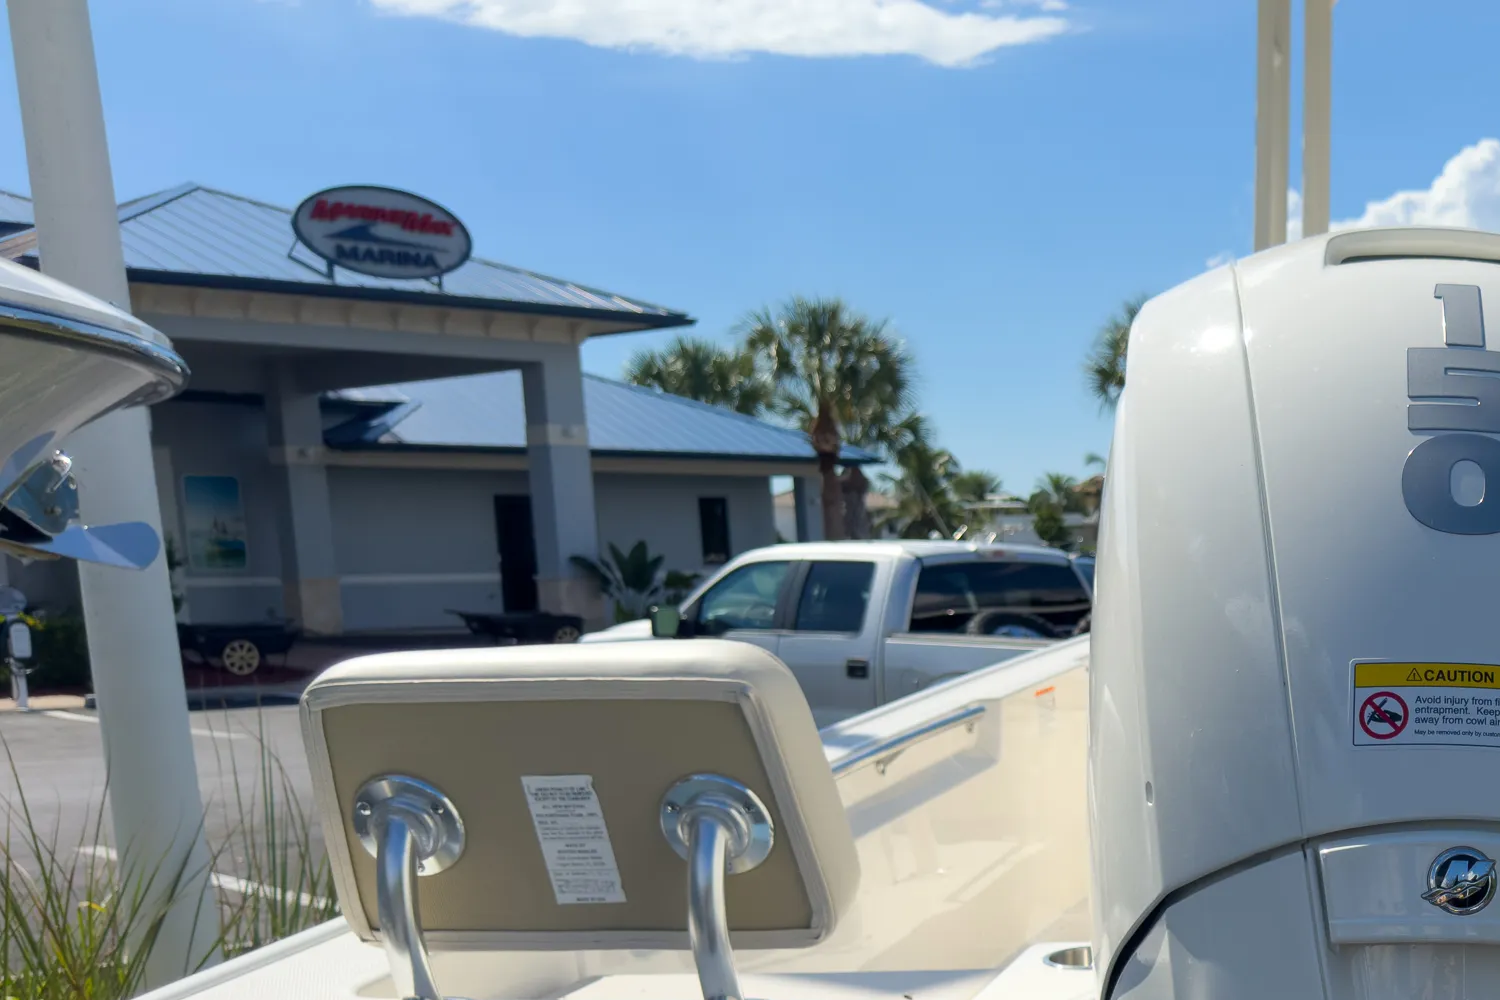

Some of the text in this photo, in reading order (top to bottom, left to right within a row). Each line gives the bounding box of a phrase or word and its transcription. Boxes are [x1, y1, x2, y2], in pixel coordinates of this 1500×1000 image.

[335, 244, 440, 269] MARINA
[1424, 669, 1494, 683] CAUTION
[1415, 696, 1441, 704] Avoid
[1443, 696, 1469, 706] injury
[1471, 697, 1492, 706] from
[1414, 707, 1470, 717] entrapment.
[1476, 707, 1500, 717] Keep
[1414, 717, 1438, 726] away
[1442, 716, 1463, 725] from
[1466, 717, 1487, 725] cowl
[1489, 717, 1500, 726] air
[1462, 730, 1473, 738] only
